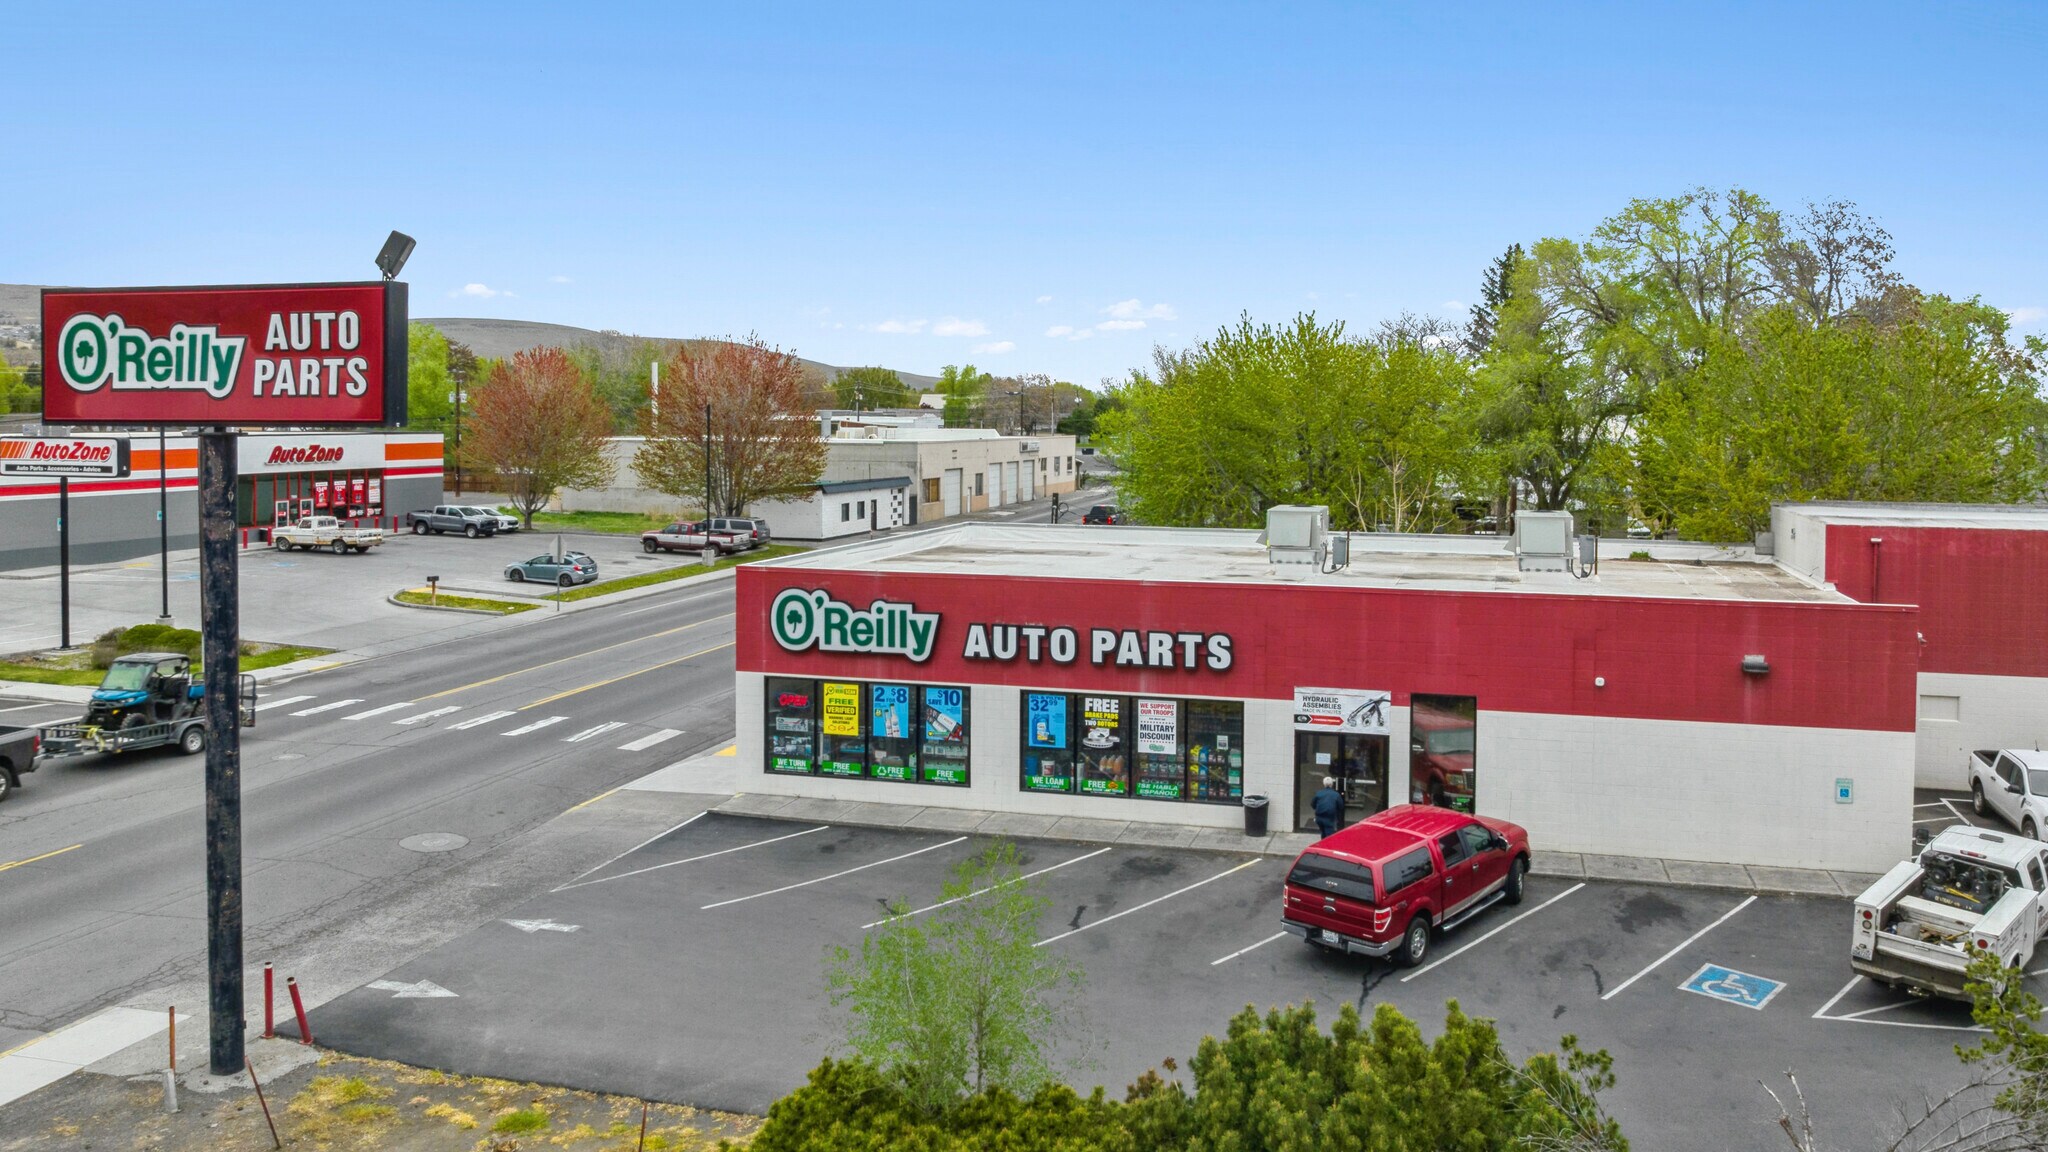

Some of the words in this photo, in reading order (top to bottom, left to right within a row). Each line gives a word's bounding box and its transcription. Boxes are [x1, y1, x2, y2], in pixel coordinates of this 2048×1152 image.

[264, 310, 360, 351] AUTO
[63, 320, 237, 391] O'Reilly
[253, 357, 368, 397] PARTS
[30, 441, 111, 461] AutoZone
[267, 444, 344, 463] AutoZone
[775, 594, 933, 657] O'Reilly
[963, 624, 1077, 662] AUTO
[1092, 629, 1232, 669] PARTS
[874, 686, 886, 703] 2
[890, 687, 908, 704] $8
[928, 698, 942, 706] SAVE
[937, 689, 961, 707] $10
[779, 693, 808, 707] OPEN
[828, 697, 854, 705] FREE
[1084, 697, 1119, 713] FREE
[827, 706, 856, 715] VERIFIED
[1104, 712, 1119, 720] PADS
[1097, 720, 1119, 728] ROTORS
[1140, 724, 1175, 732] MILITARY
[1139, 732, 1175, 741] DISCOUNT
[777, 758, 788, 766] WE
[789, 759, 807, 767] TURN
[833, 761, 850, 770] FREE
[887, 766, 905, 775] FREE
[936, 769, 954, 778] FREE
[1032, 776, 1044, 784] WE
[1045, 777, 1064, 785] LOAN
[1088, 780, 1106, 789] FREE
